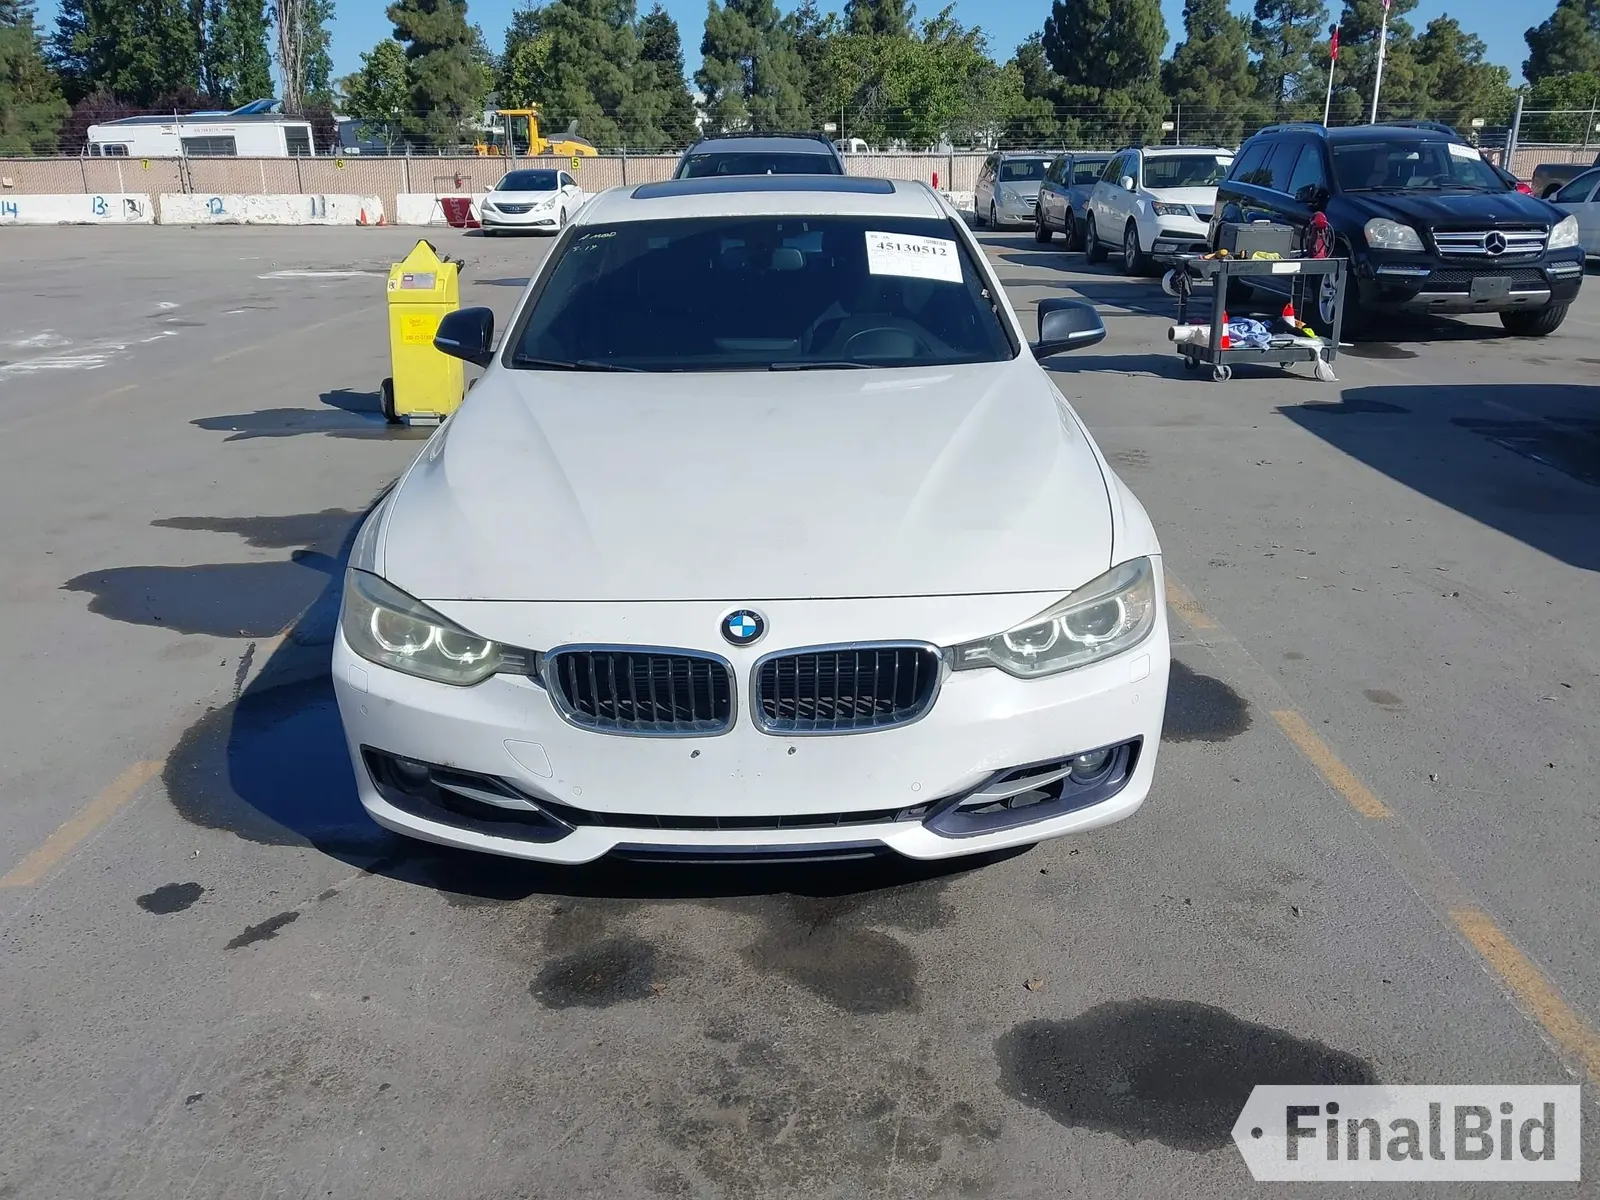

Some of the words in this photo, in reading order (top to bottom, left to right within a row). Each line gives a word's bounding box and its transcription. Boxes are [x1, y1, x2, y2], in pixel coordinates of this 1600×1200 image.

[143, 160, 148, 169] 7
[337, 159, 344, 168] 6
[572, 159, 579, 167] 5
[1, 200, 18, 218] 14
[876, 242, 947, 257] 45130512
[726, 610, 761, 622] BMW
